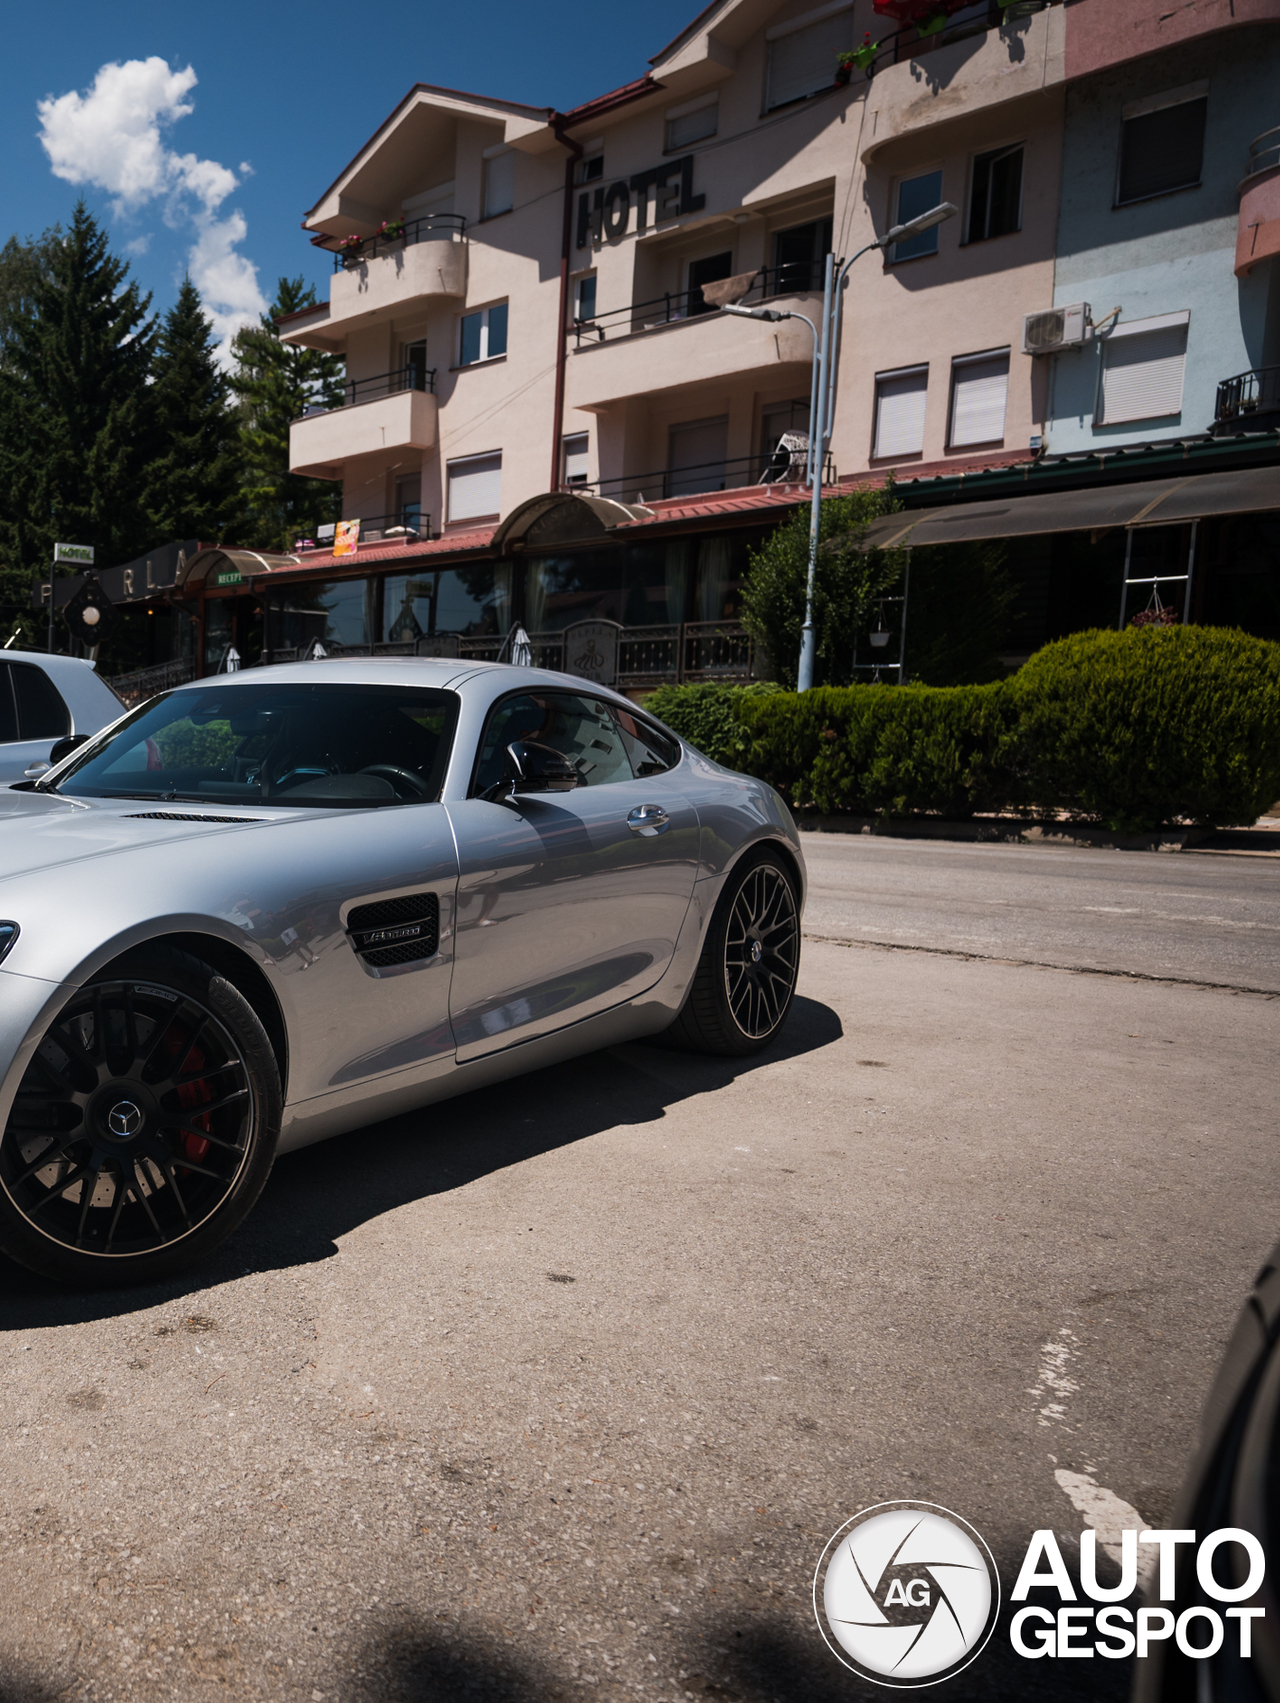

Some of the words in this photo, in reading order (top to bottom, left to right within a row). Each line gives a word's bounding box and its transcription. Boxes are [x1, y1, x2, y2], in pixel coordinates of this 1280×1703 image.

[576, 154, 706, 249] HOTEL
[40, 548, 187, 604] PRLA
[58, 546, 94, 560] HOTEL
